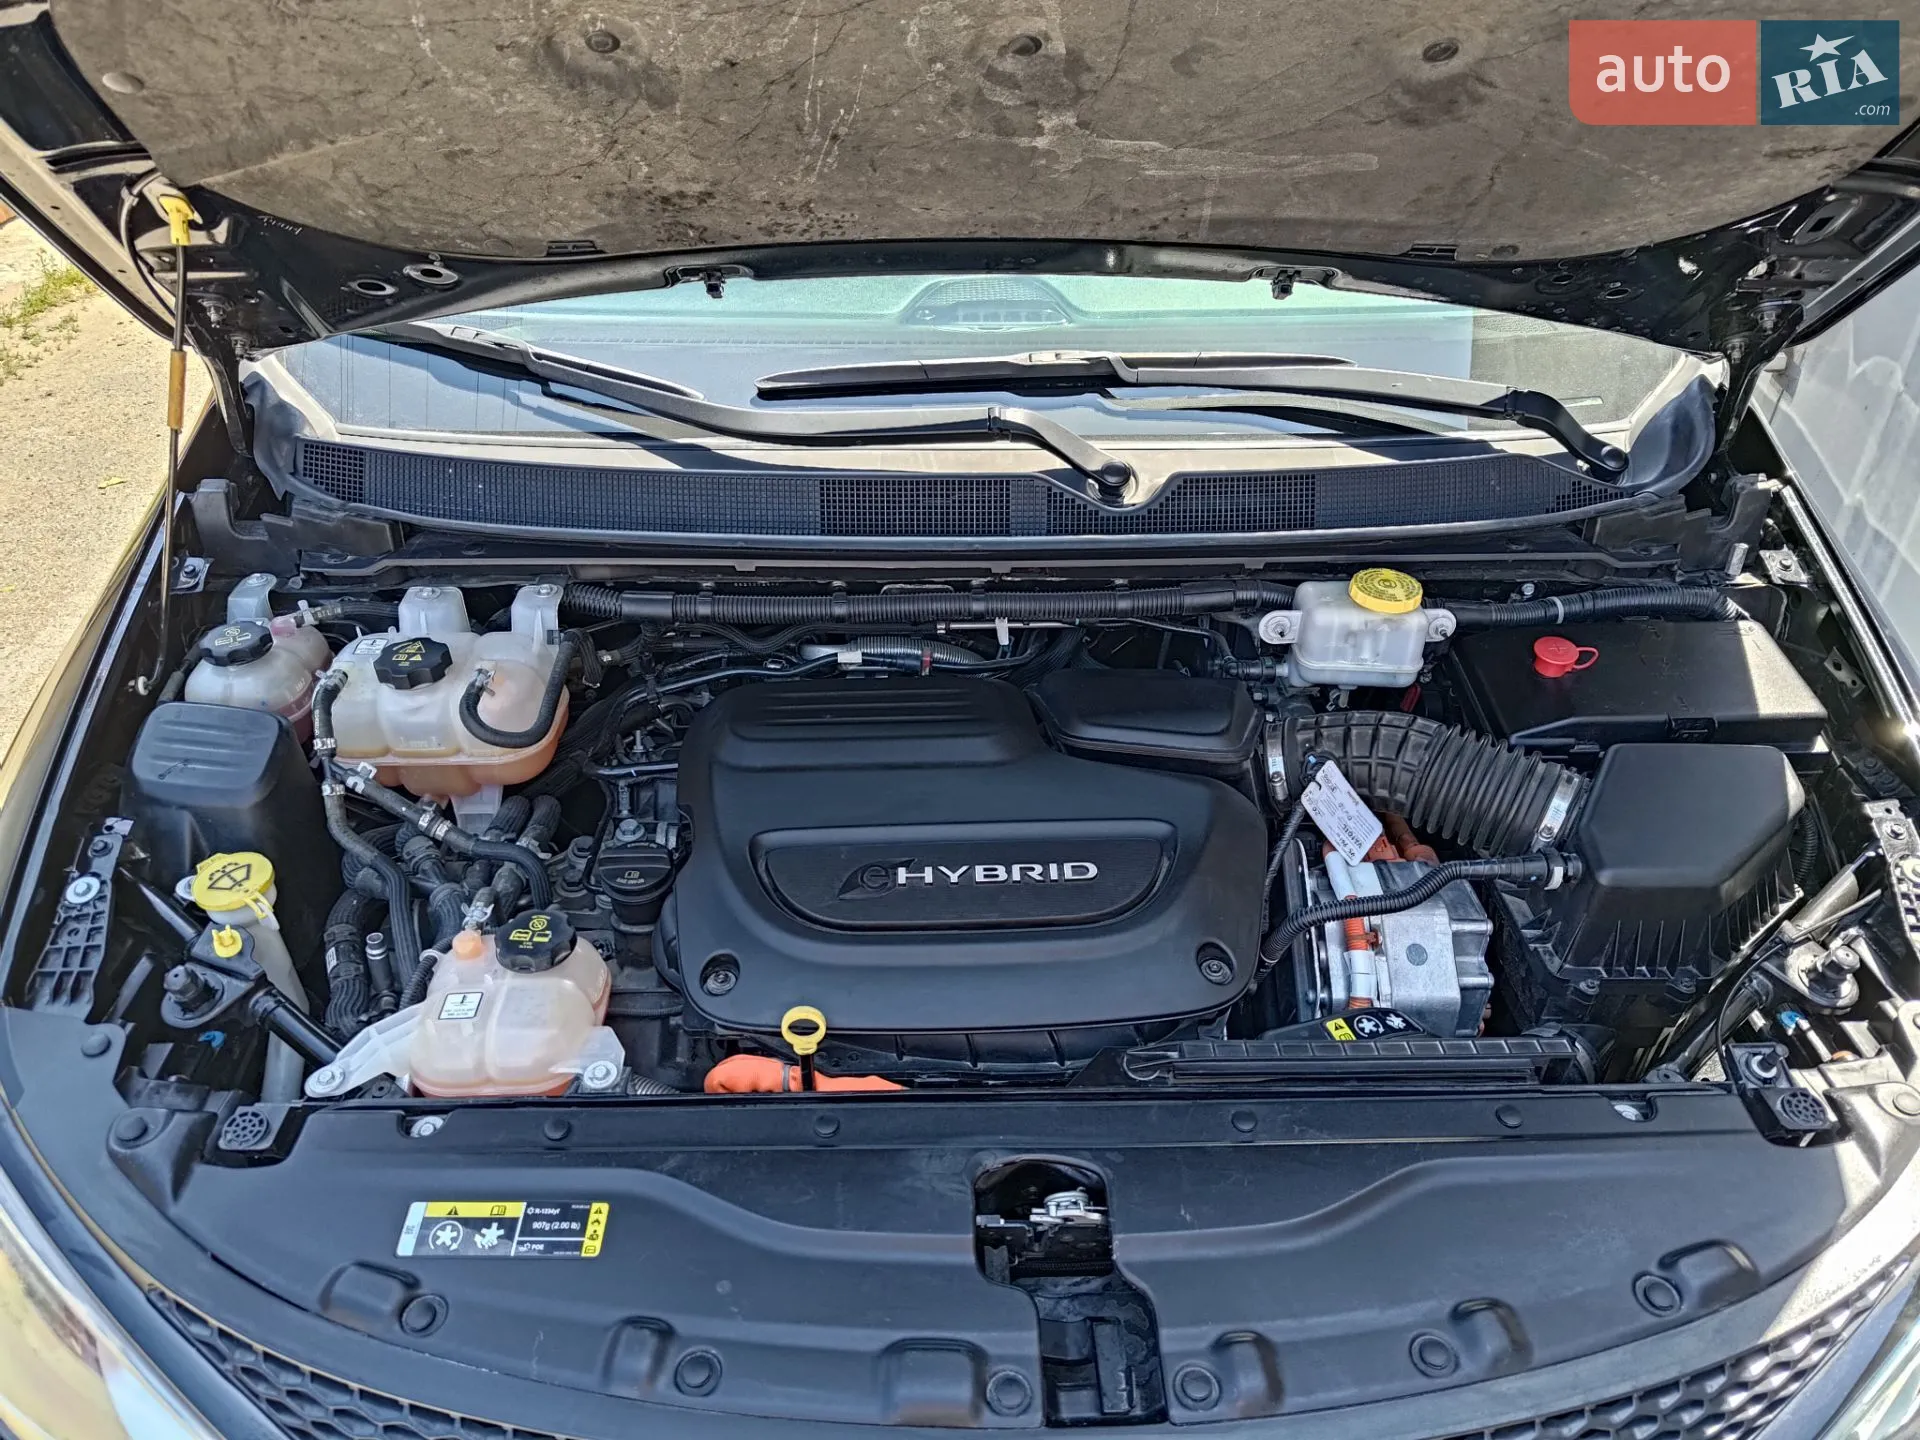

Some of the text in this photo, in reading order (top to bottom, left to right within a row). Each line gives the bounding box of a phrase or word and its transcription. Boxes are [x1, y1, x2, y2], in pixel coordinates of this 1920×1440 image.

[532, 1221, 581, 1231] 907g (2.00 lb)
[531, 1243, 545, 1251] POE
